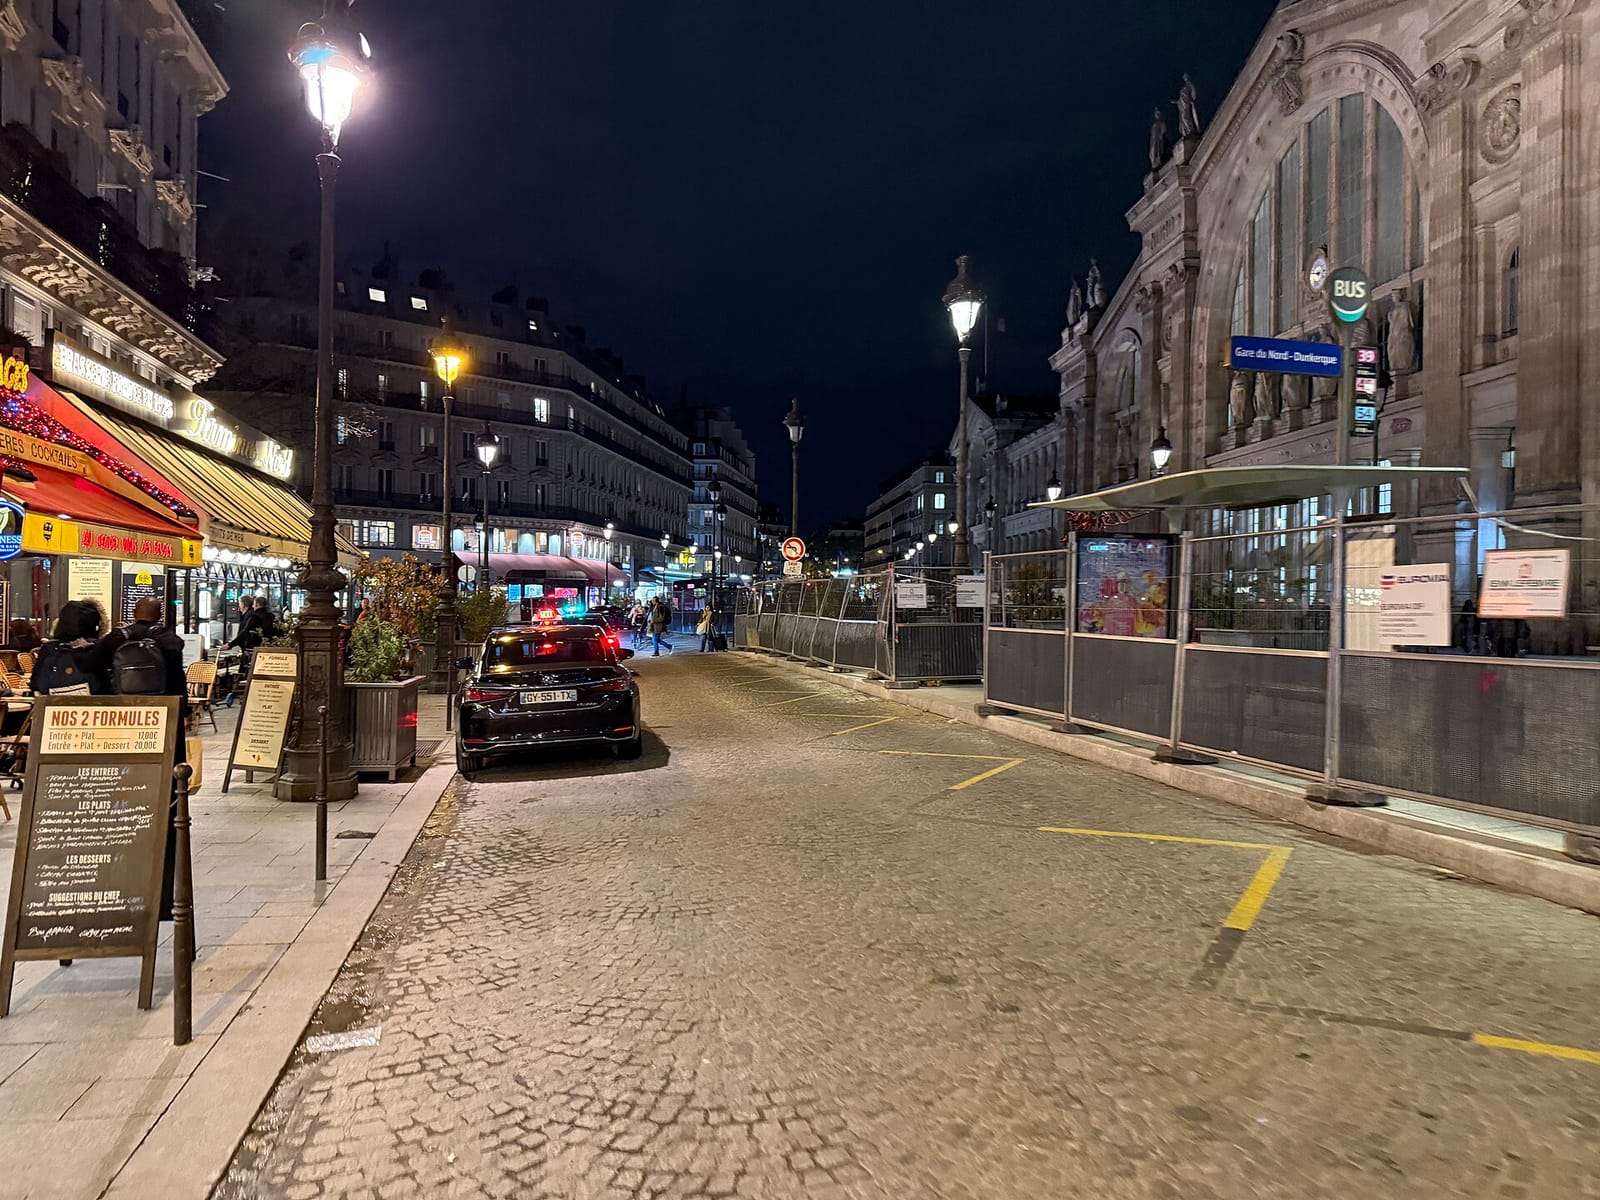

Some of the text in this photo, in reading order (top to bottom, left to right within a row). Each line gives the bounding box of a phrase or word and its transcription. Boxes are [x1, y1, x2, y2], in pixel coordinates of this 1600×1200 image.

[1334, 280, 1366, 298] BUS
[1235, 347, 1255, 357] Gare
[1256, 348, 1267, 358] du
[1267, 350, 1289, 360] Nord
[1293, 352, 1337, 366] Dunkerque
[1358, 350, 1375, 362] 39
[1357, 407, 1372, 419] 54
[31, 442, 78, 469] COCKTAILS
[527, 691, 572, 703] GY-551-TX
[51, 710, 160, 727] NOS 2 FORMULES
[49, 731, 72, 740] Entrée
[81, 731, 95, 740] Plat
[48, 741, 71, 750] Entrée
[80, 741, 94, 750] Plat
[103, 741, 130, 750] Dessert
[78, 768, 90, 777] LES
[90, 767, 119, 777] ENTREES
[78, 801, 91, 810] LES
[91, 801, 111, 810] PLATS
[66, 854, 112, 865] LES DESSERTS
[48, 890, 120, 902] SUGGESTIONS DU CHEF
